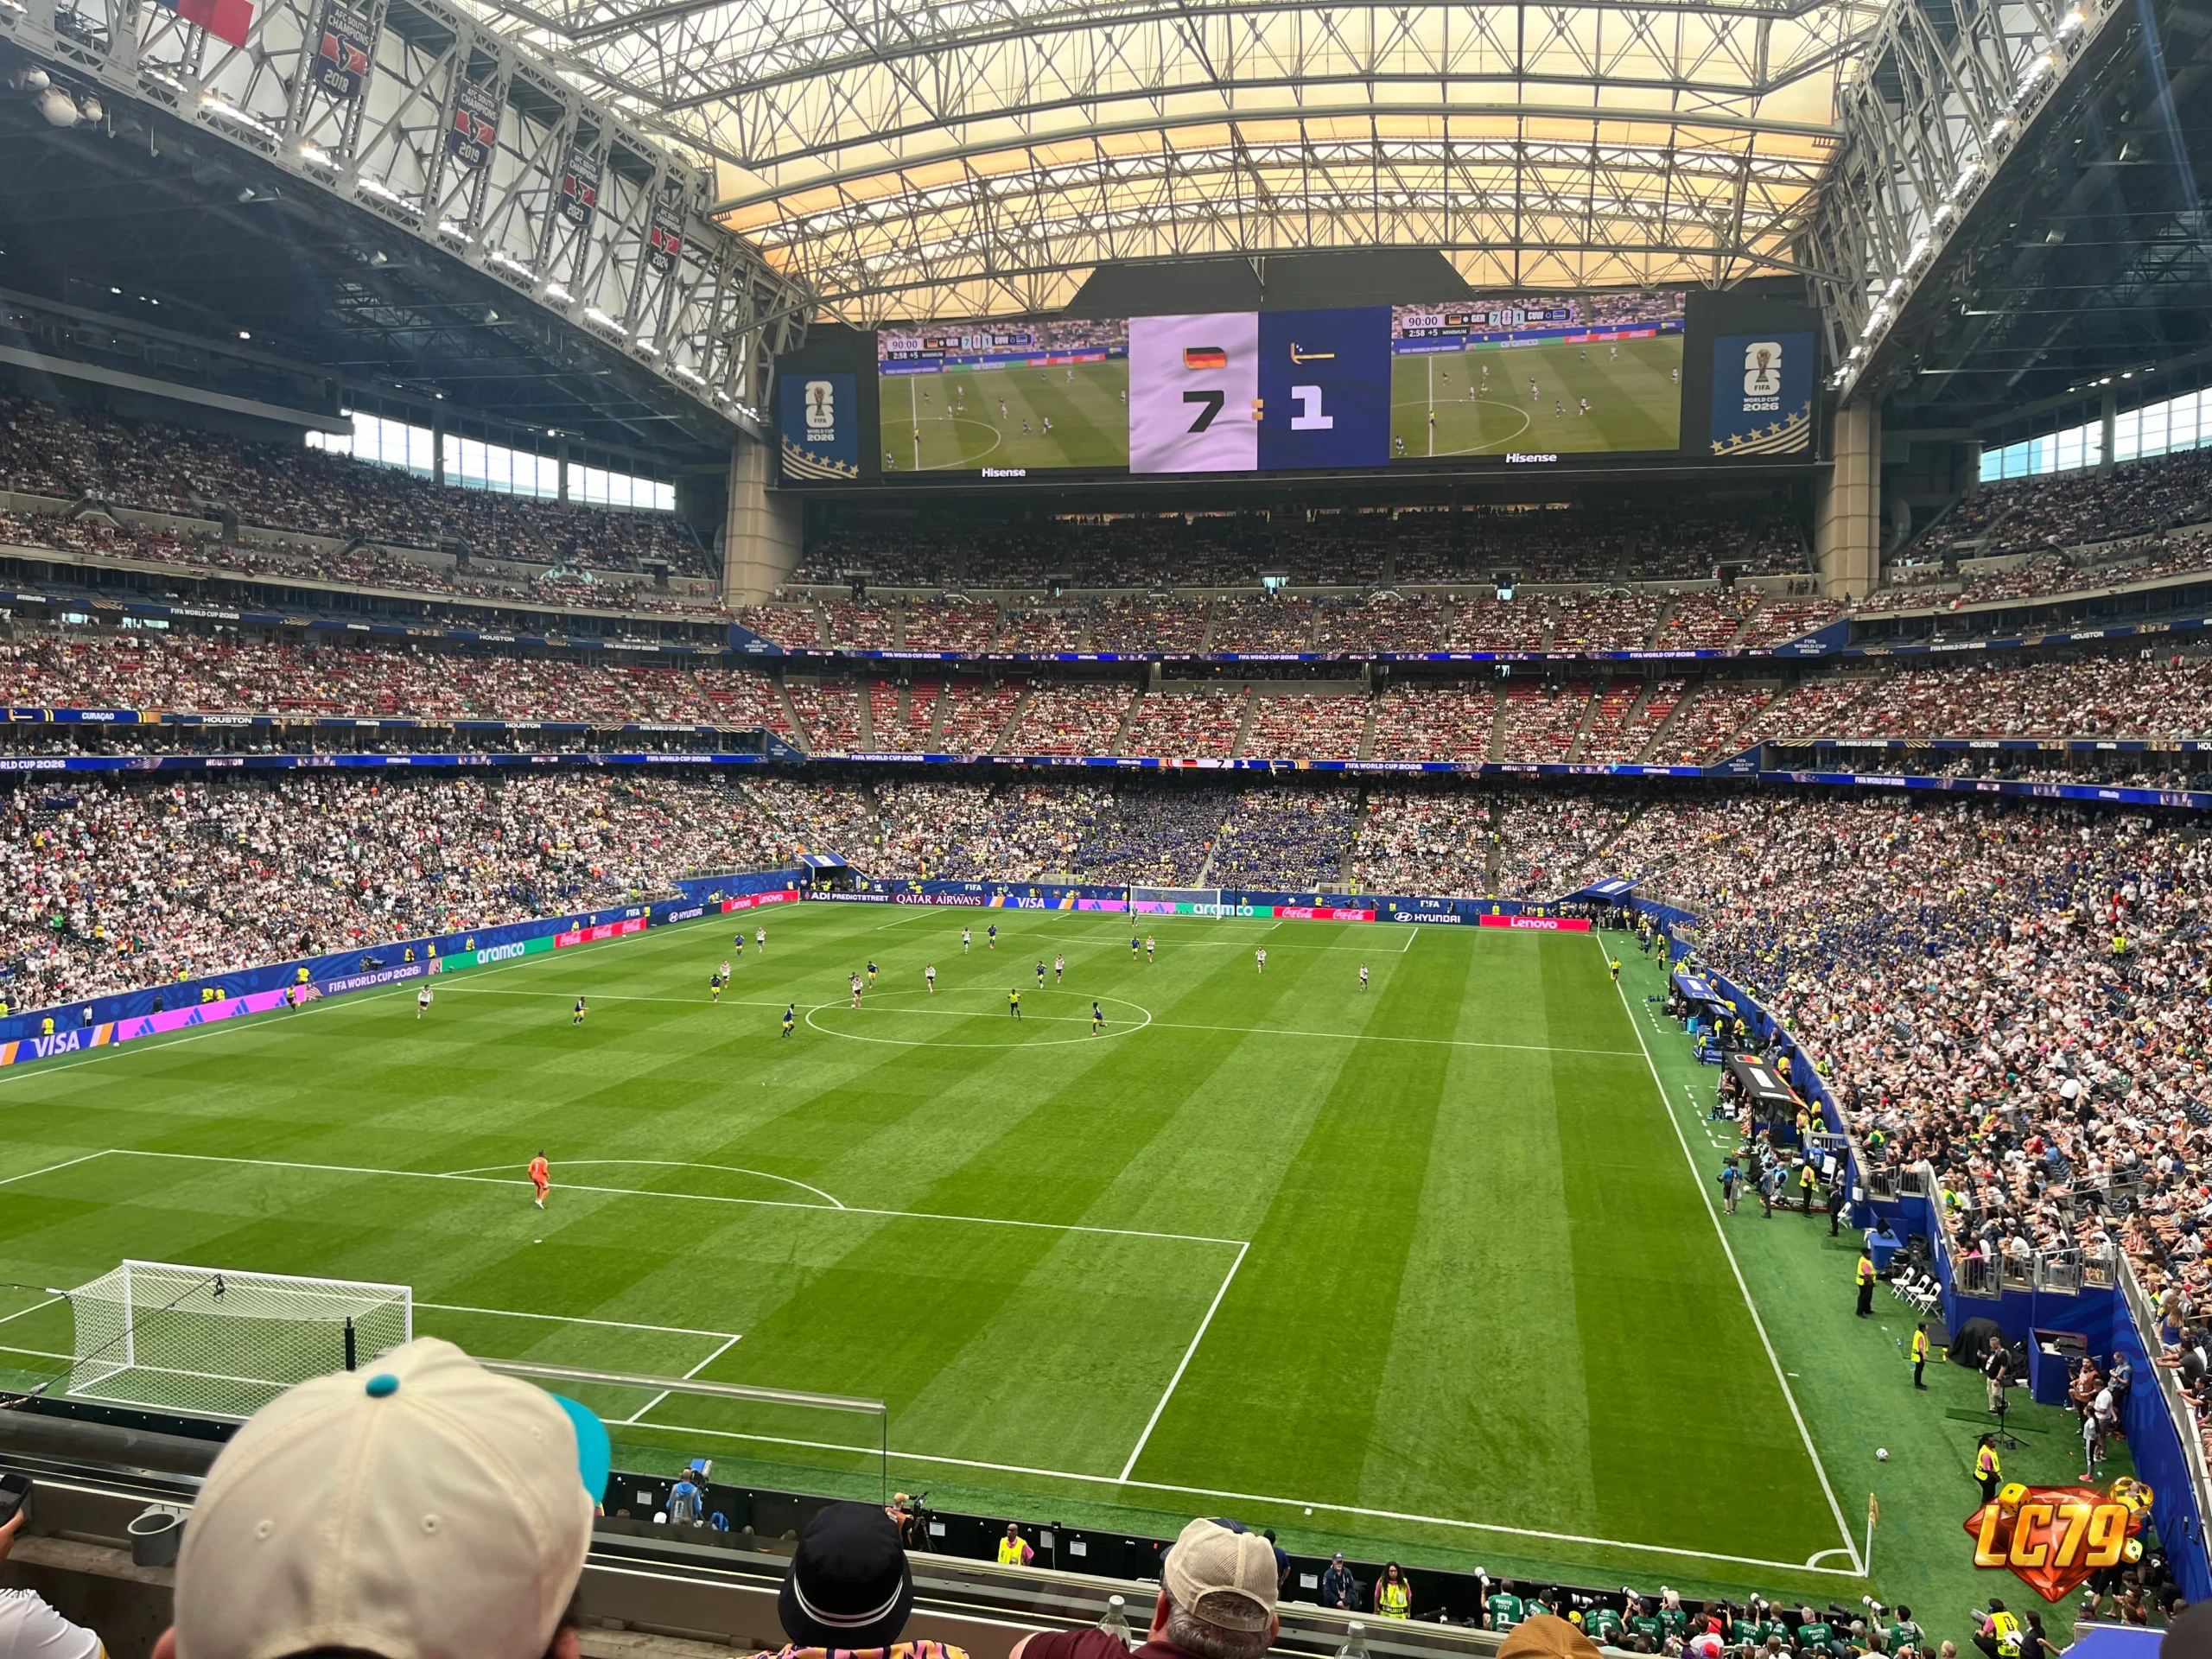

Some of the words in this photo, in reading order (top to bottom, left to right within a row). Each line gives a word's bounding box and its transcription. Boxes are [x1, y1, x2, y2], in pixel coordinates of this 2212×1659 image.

[335, 9, 346, 22] AFC
[347, 16, 367, 33] SOUTH
[328, 15, 369, 46] CHAMPIONS
[324, 68, 349, 92] 2018
[467, 88, 477, 97] AFC
[479, 93, 494, 108] SOUTH
[461, 93, 496, 121] CHAMPIONS
[459, 142, 480, 162] 2019
[570, 160, 598, 183] CHAMPIONS
[567, 202, 584, 222] 2023
[653, 252, 669, 270] 2024
[1408, 317, 1437, 326] 90:00
[1471, 314, 1485, 322] GER
[1528, 311, 1544, 321] CUW
[893, 340, 918, 350] 90:00
[1183, 391, 1224, 433] 7
[1291, 385, 1333, 430] 1
[1743, 403, 1779, 411] 2026
[1506, 454, 1557, 463] Hisense
[982, 467, 1026, 477] Hisense
[480, 634, 515, 643] HOUSTON
[82, 712, 114, 721] CURAÇAO
[37, 760, 66, 769] 2026
[732, 899, 751, 910] Lenovo
[760, 894, 783, 904] Lenovo
[897, 894, 931, 904] QATAR
[936, 895, 981, 906] AIRWAYS
[1015, 898, 1045, 908] VISA
[626, 908, 640, 917] FIFA
[679, 907, 702, 919] HYUNDAI
[1193, 904, 1254, 916] aramco
[1414, 914, 1460, 923] HYUNDAI
[1511, 917, 1557, 929] Lenovo
[477, 942, 524, 964] aramco
[329, 981, 346, 992] FIFA
[348, 975, 376, 988] WORLD
[378, 971, 391, 982] CUP
[393, 966, 419, 979] 2026
[30, 1031, 79, 1058] VISA
[1741, 1623, 1758, 1631] PHOTO
